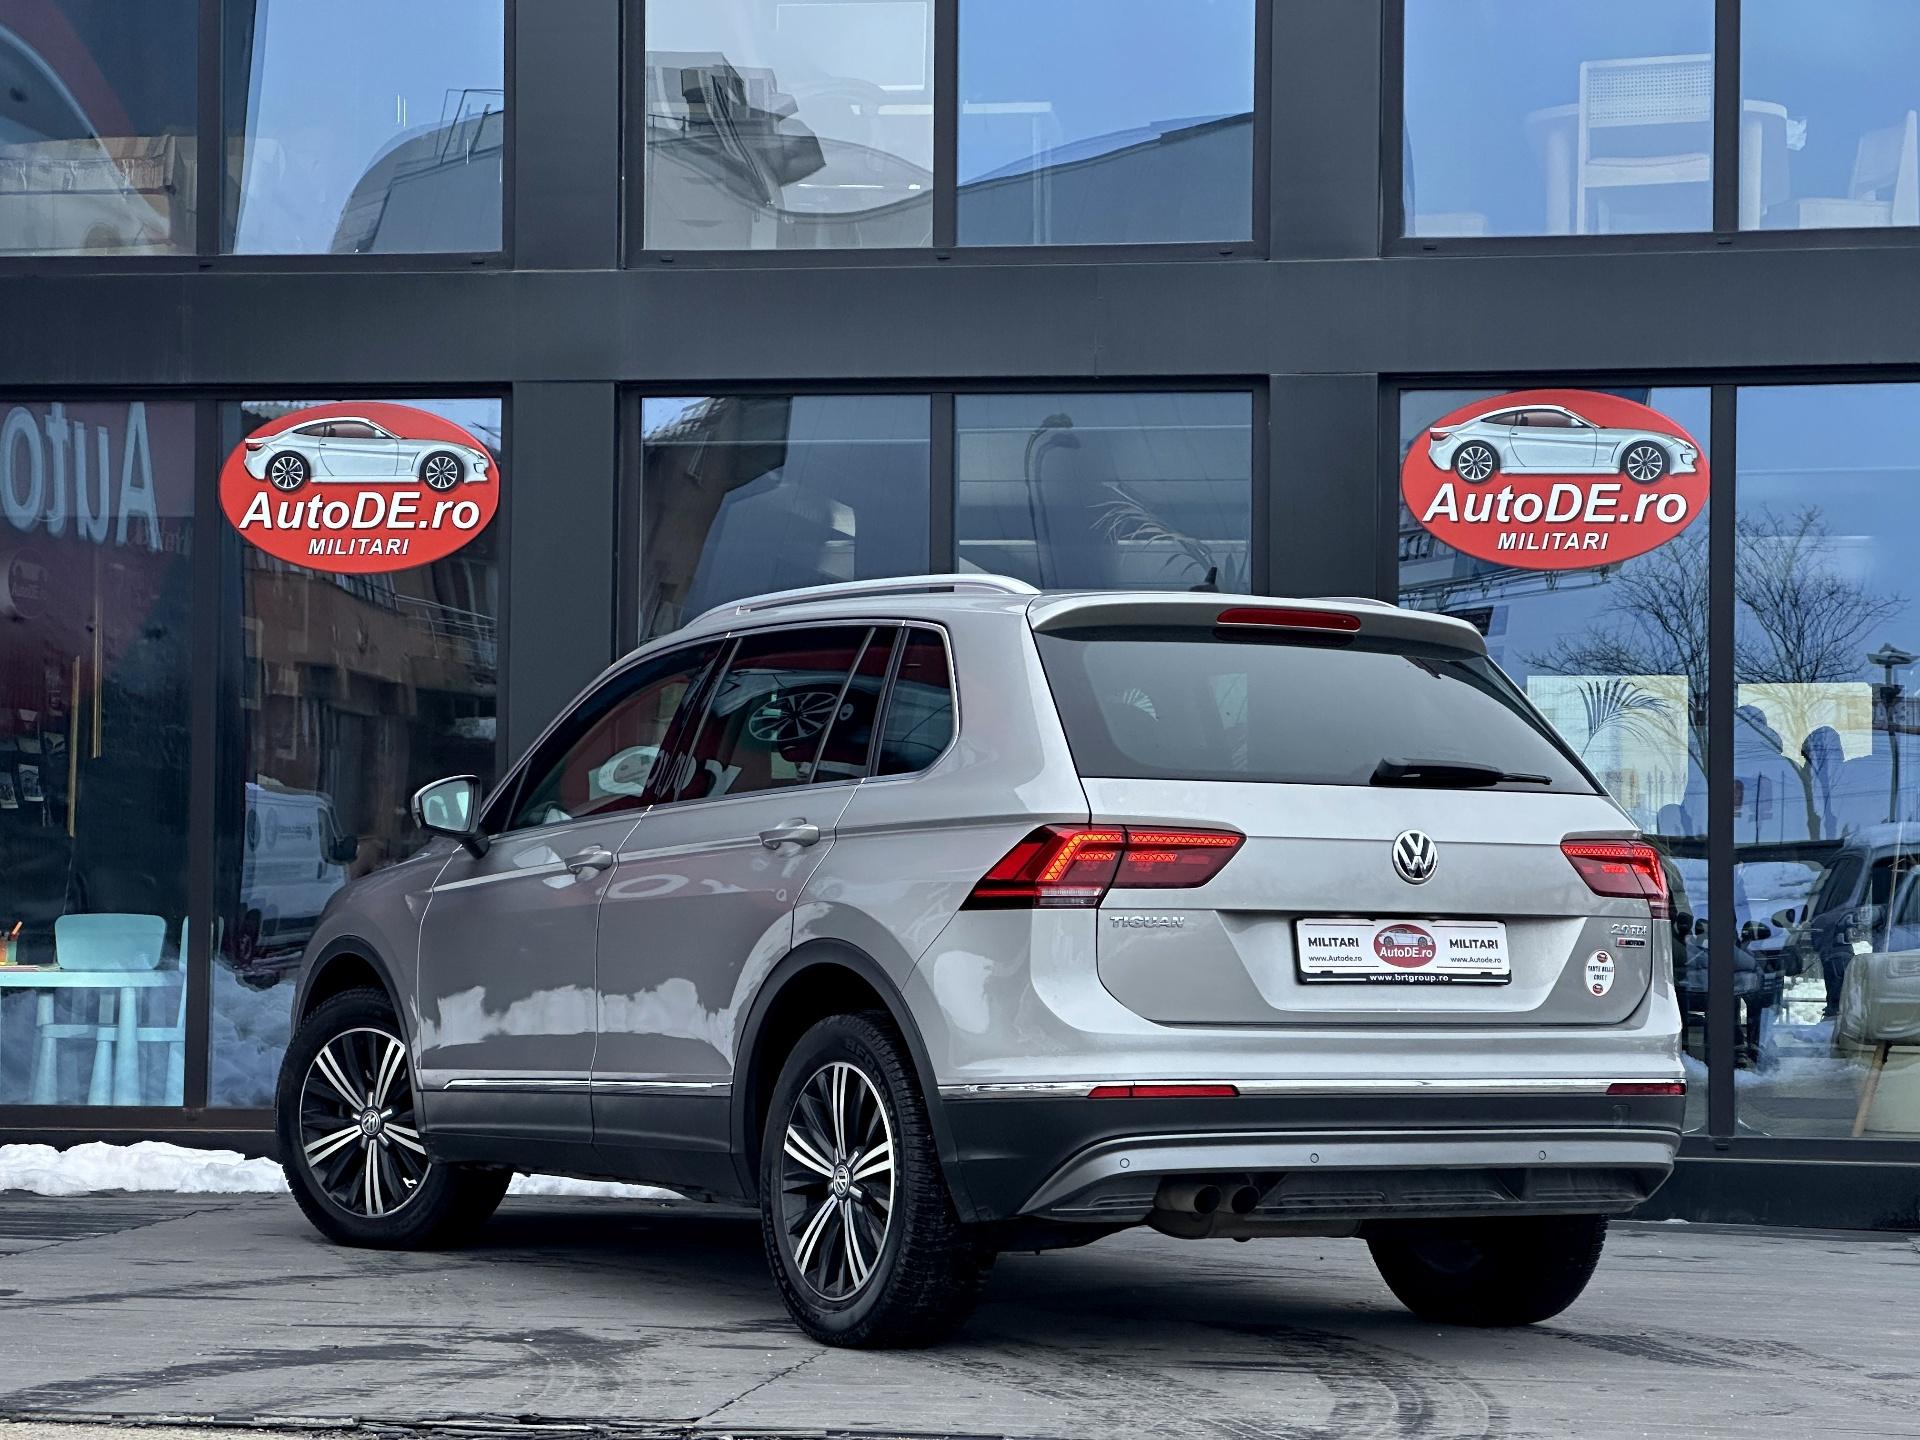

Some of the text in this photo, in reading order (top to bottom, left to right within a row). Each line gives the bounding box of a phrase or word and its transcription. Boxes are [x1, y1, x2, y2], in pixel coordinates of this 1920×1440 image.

[1422, 483, 1689, 524] AutoDE.ro
[239, 491, 481, 530] AutoDE.ro
[307, 538, 410, 555] MILITARI
[1497, 532, 1609, 551] MILITARI
[1109, 915, 1185, 928] TIGUAN
[1308, 937, 1360, 948] MILITARI
[1449, 938, 1499, 949] MILITARI
[1380, 946, 1433, 958] AutoDE.ro
[1450, 956, 1502, 964] www.Autode.ro
[1369, 973, 1449, 982] www.brtgroup.ro
